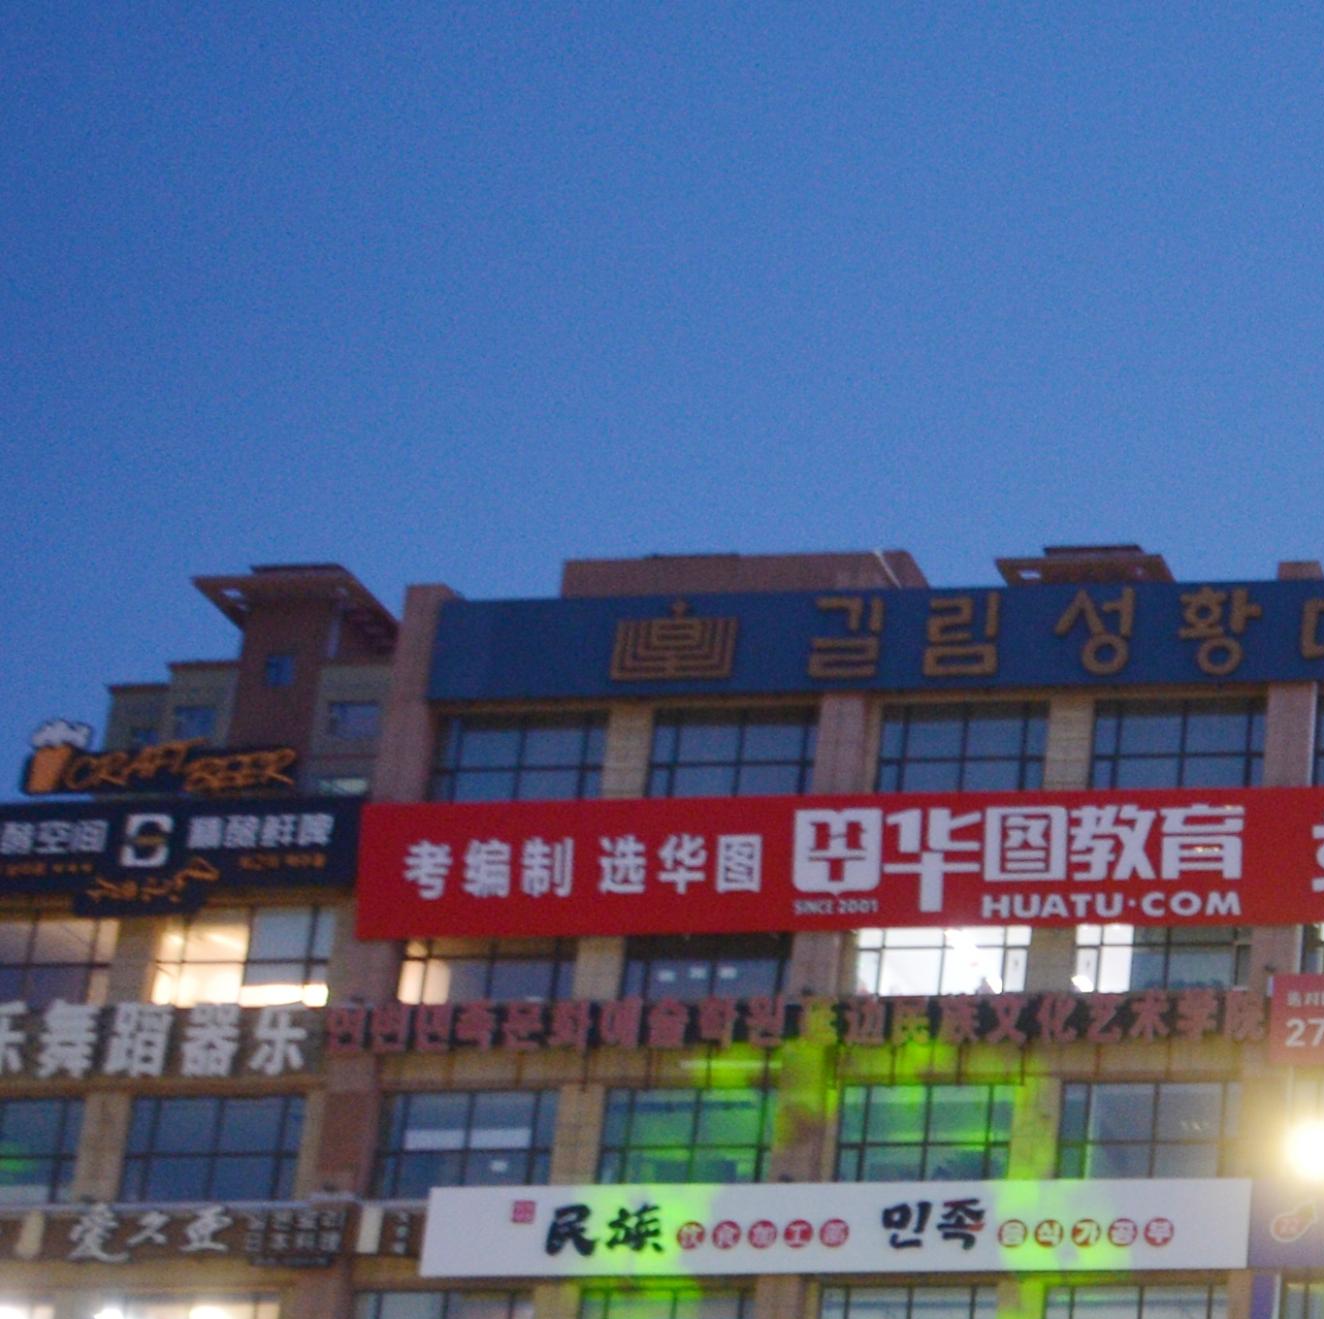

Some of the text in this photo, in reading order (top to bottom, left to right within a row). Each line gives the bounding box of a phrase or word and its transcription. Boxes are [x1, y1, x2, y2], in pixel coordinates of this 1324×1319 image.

[403, 833, 765, 900] 考编制 选华图
[883, 802, 1248, 914] 华图教育
[838, 900, 880, 916] 2001
[545, 1203, 665, 1256] 民族
[882, 1197, 986, 1250] 민족
